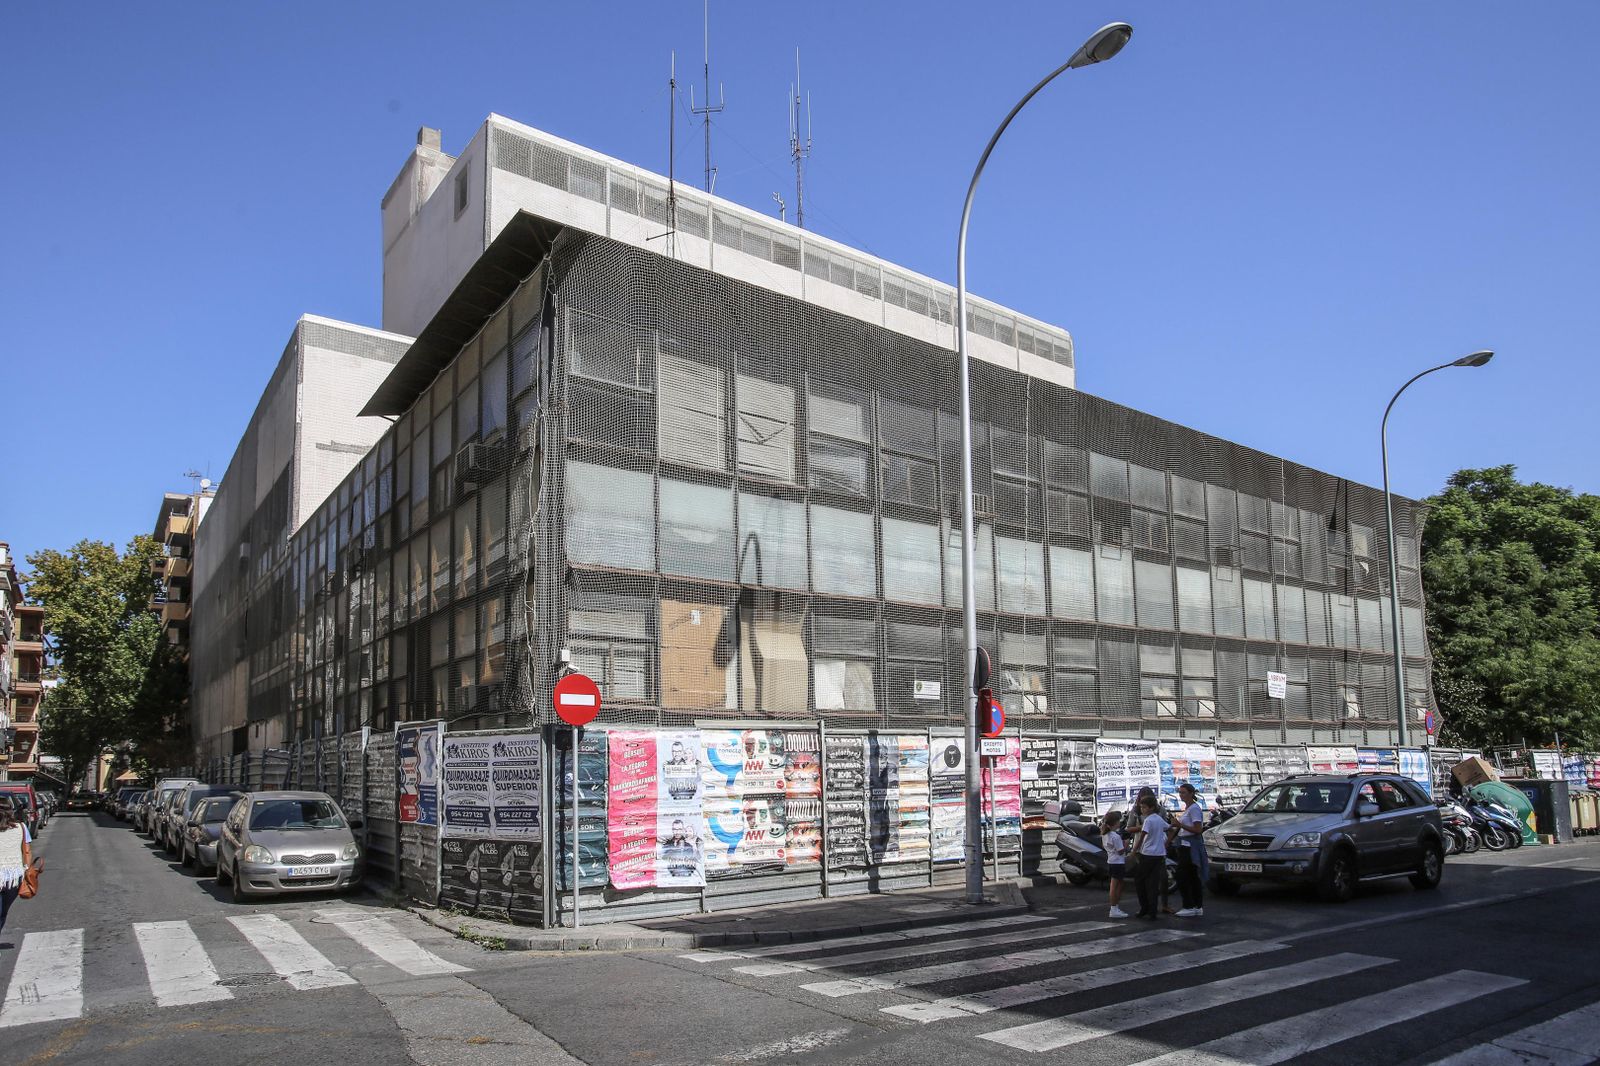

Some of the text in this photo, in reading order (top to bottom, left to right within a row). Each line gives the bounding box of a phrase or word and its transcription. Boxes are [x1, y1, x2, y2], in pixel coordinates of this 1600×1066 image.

[446, 770, 489, 783] QUIROMASAJE
[493, 769, 540, 783] QUIROMASAJE
[448, 783, 488, 791] SUPERIOR
[496, 782, 538, 791] SUPERIOR
[293, 867, 313, 875] 0453
